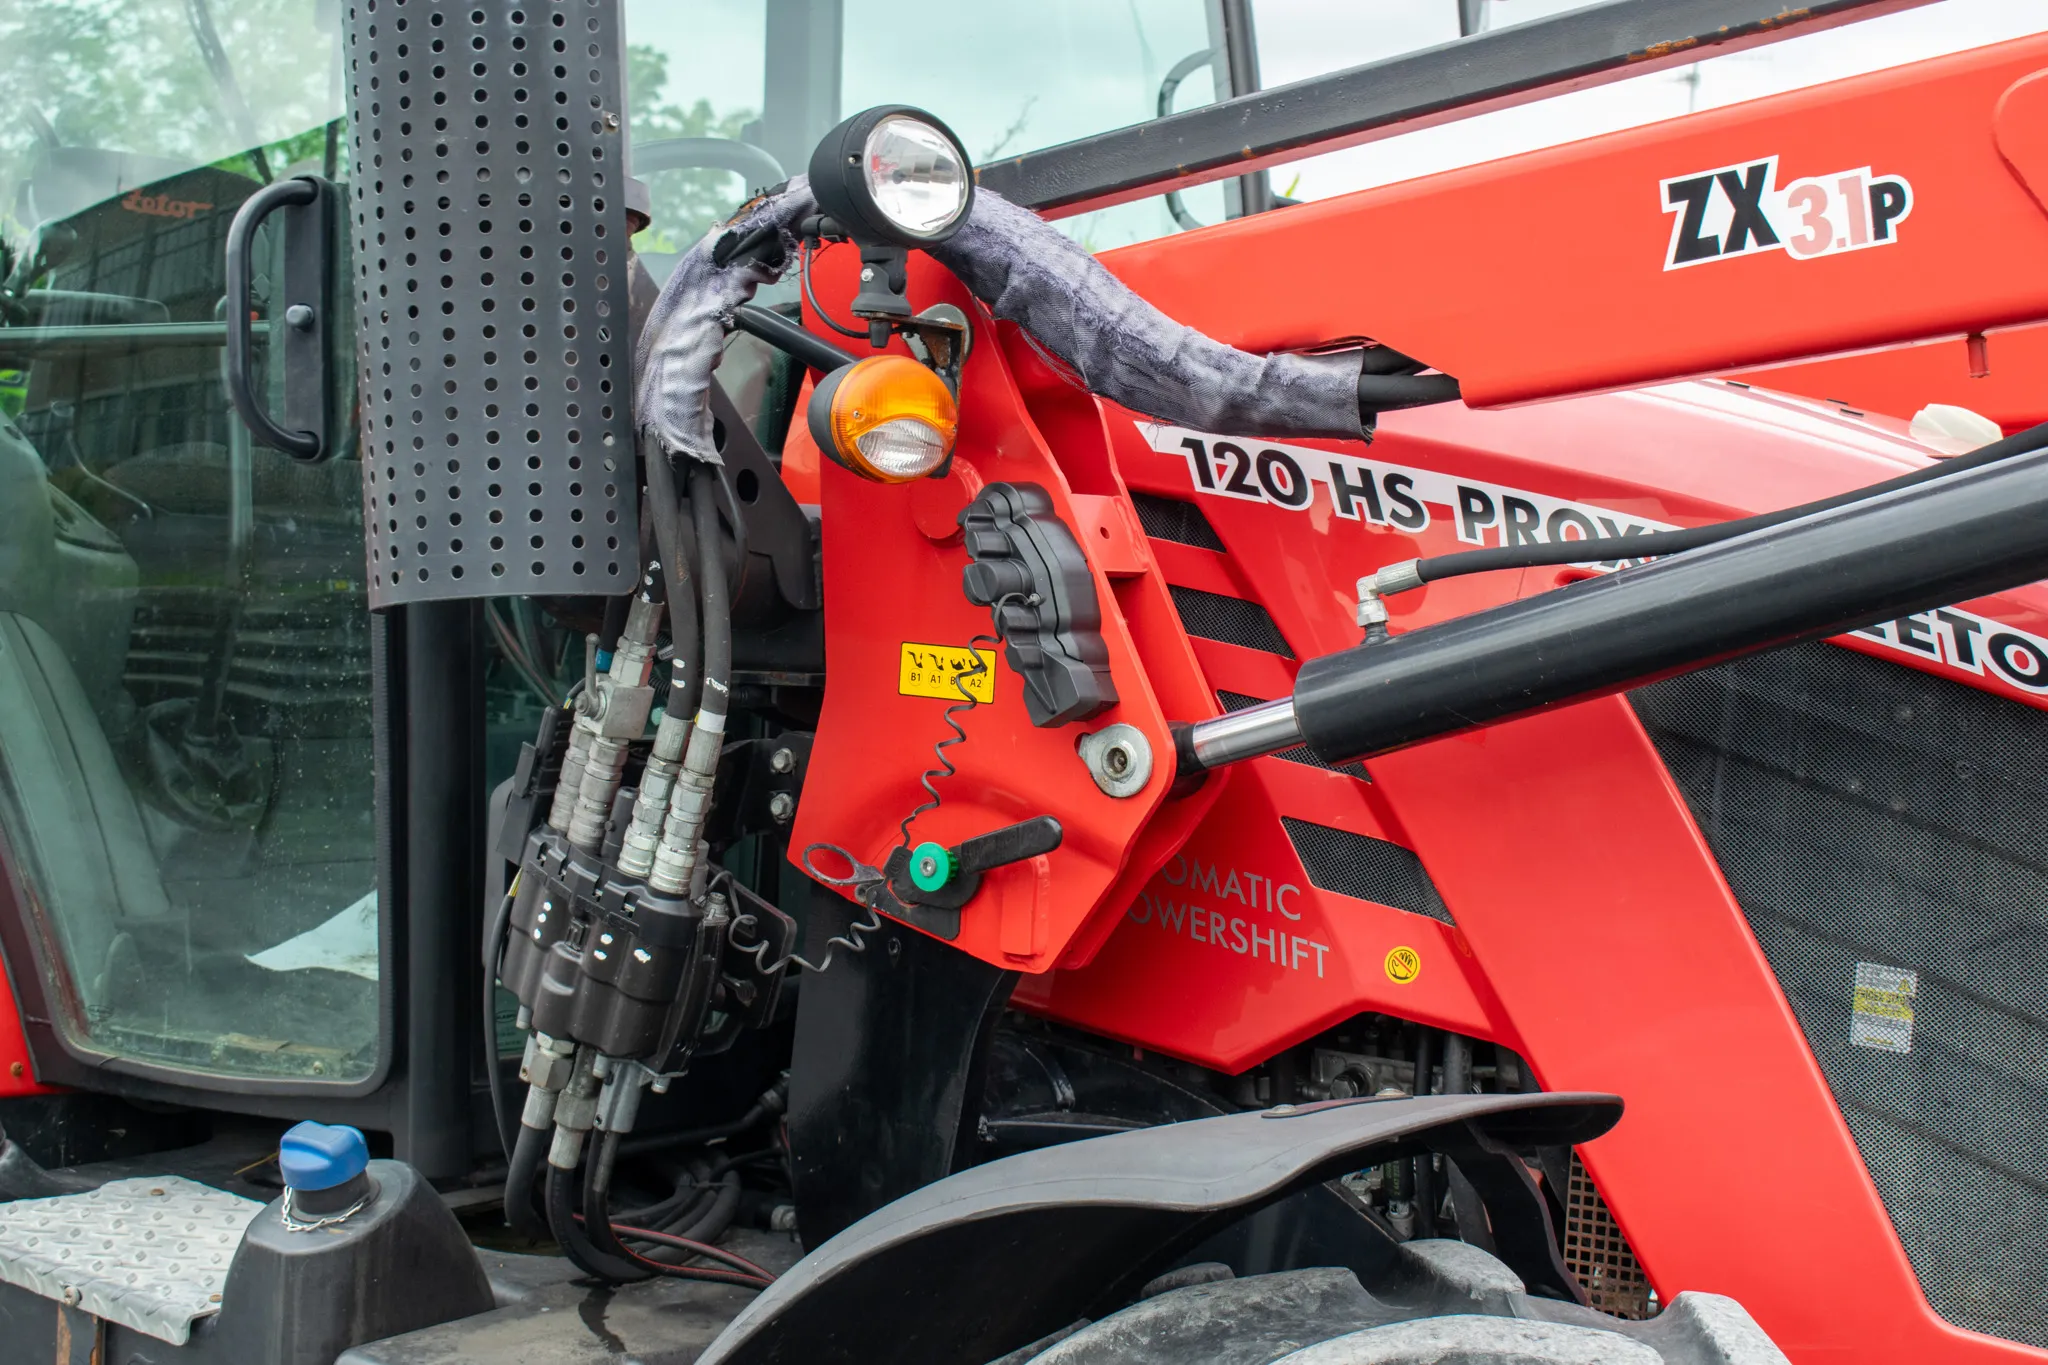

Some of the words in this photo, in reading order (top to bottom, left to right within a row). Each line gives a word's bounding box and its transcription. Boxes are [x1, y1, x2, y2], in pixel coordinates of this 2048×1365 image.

[1180, 437, 1310, 507] 120
[1328, 462, 1426, 529] HS
[910, 672, 921, 682] B1
[930, 674, 941, 684] A1
[969, 678, 982, 688] A2
